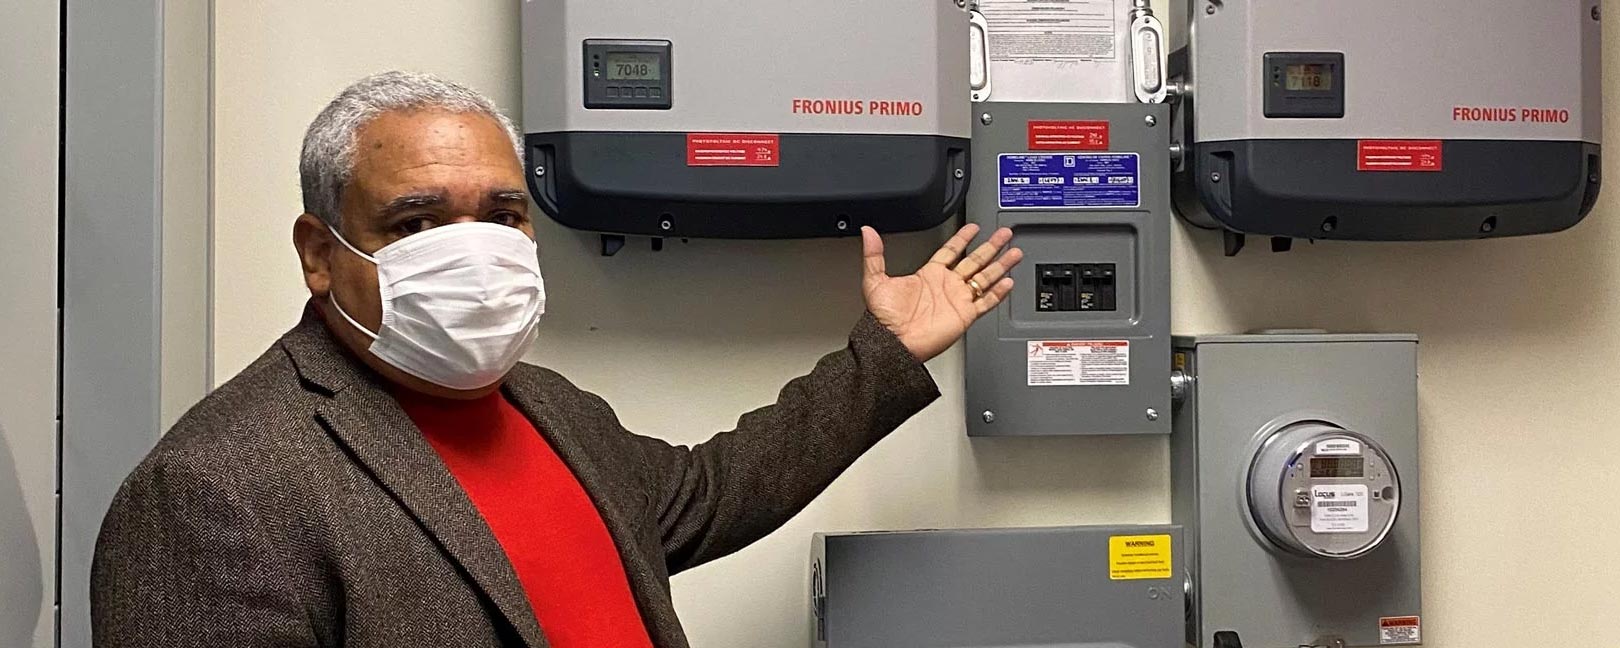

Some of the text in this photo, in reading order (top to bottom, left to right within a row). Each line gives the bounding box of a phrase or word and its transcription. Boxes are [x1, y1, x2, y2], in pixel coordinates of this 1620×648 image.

[616, 64, 648, 76] 7048
[1291, 75, 1321, 87] 7118
[792, 99, 923, 116] FRONIUS PRIMO
[1453, 107, 1569, 123] FRONIUS PRIMO
